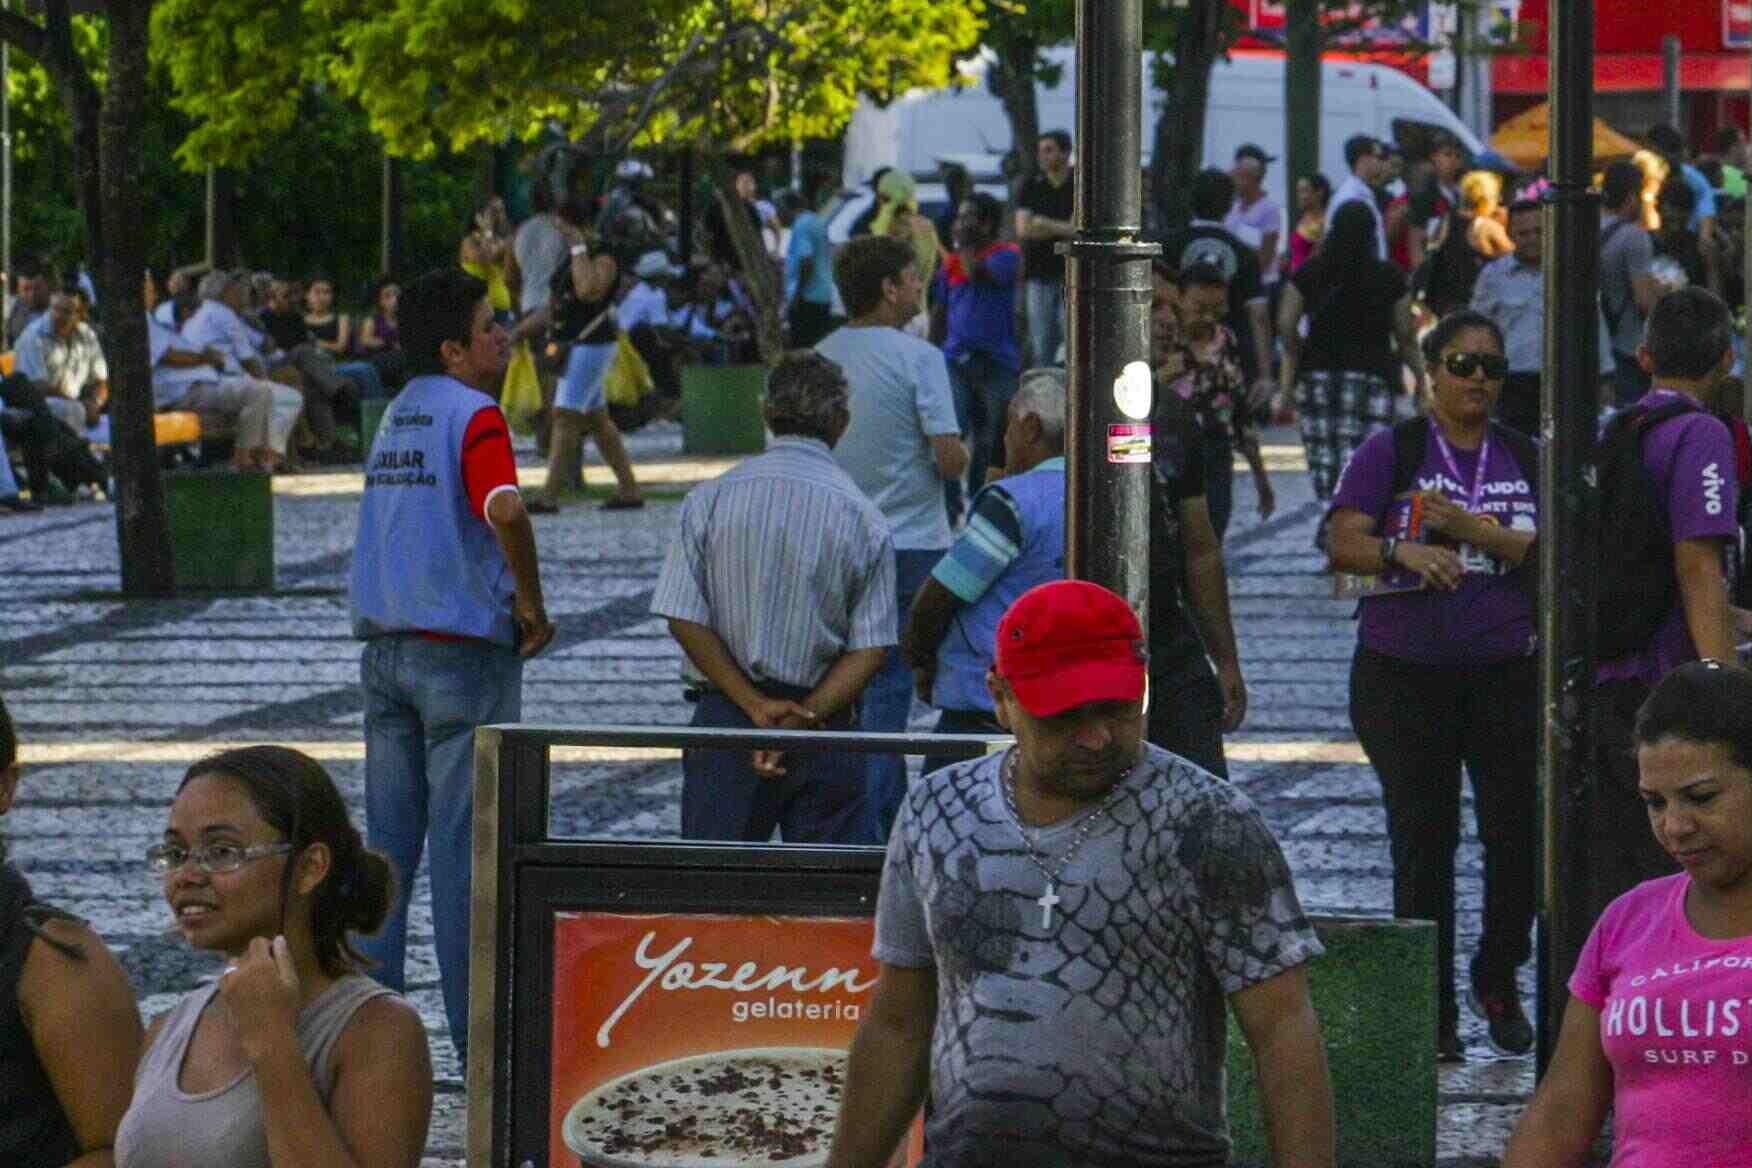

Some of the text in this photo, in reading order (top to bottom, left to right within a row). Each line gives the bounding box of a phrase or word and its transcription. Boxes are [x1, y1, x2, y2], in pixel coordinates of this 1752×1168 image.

[1702, 462, 1726, 514] vivo
[731, 997, 860, 1022] gelateria
[1644, 1048, 1717, 1066] SURF
